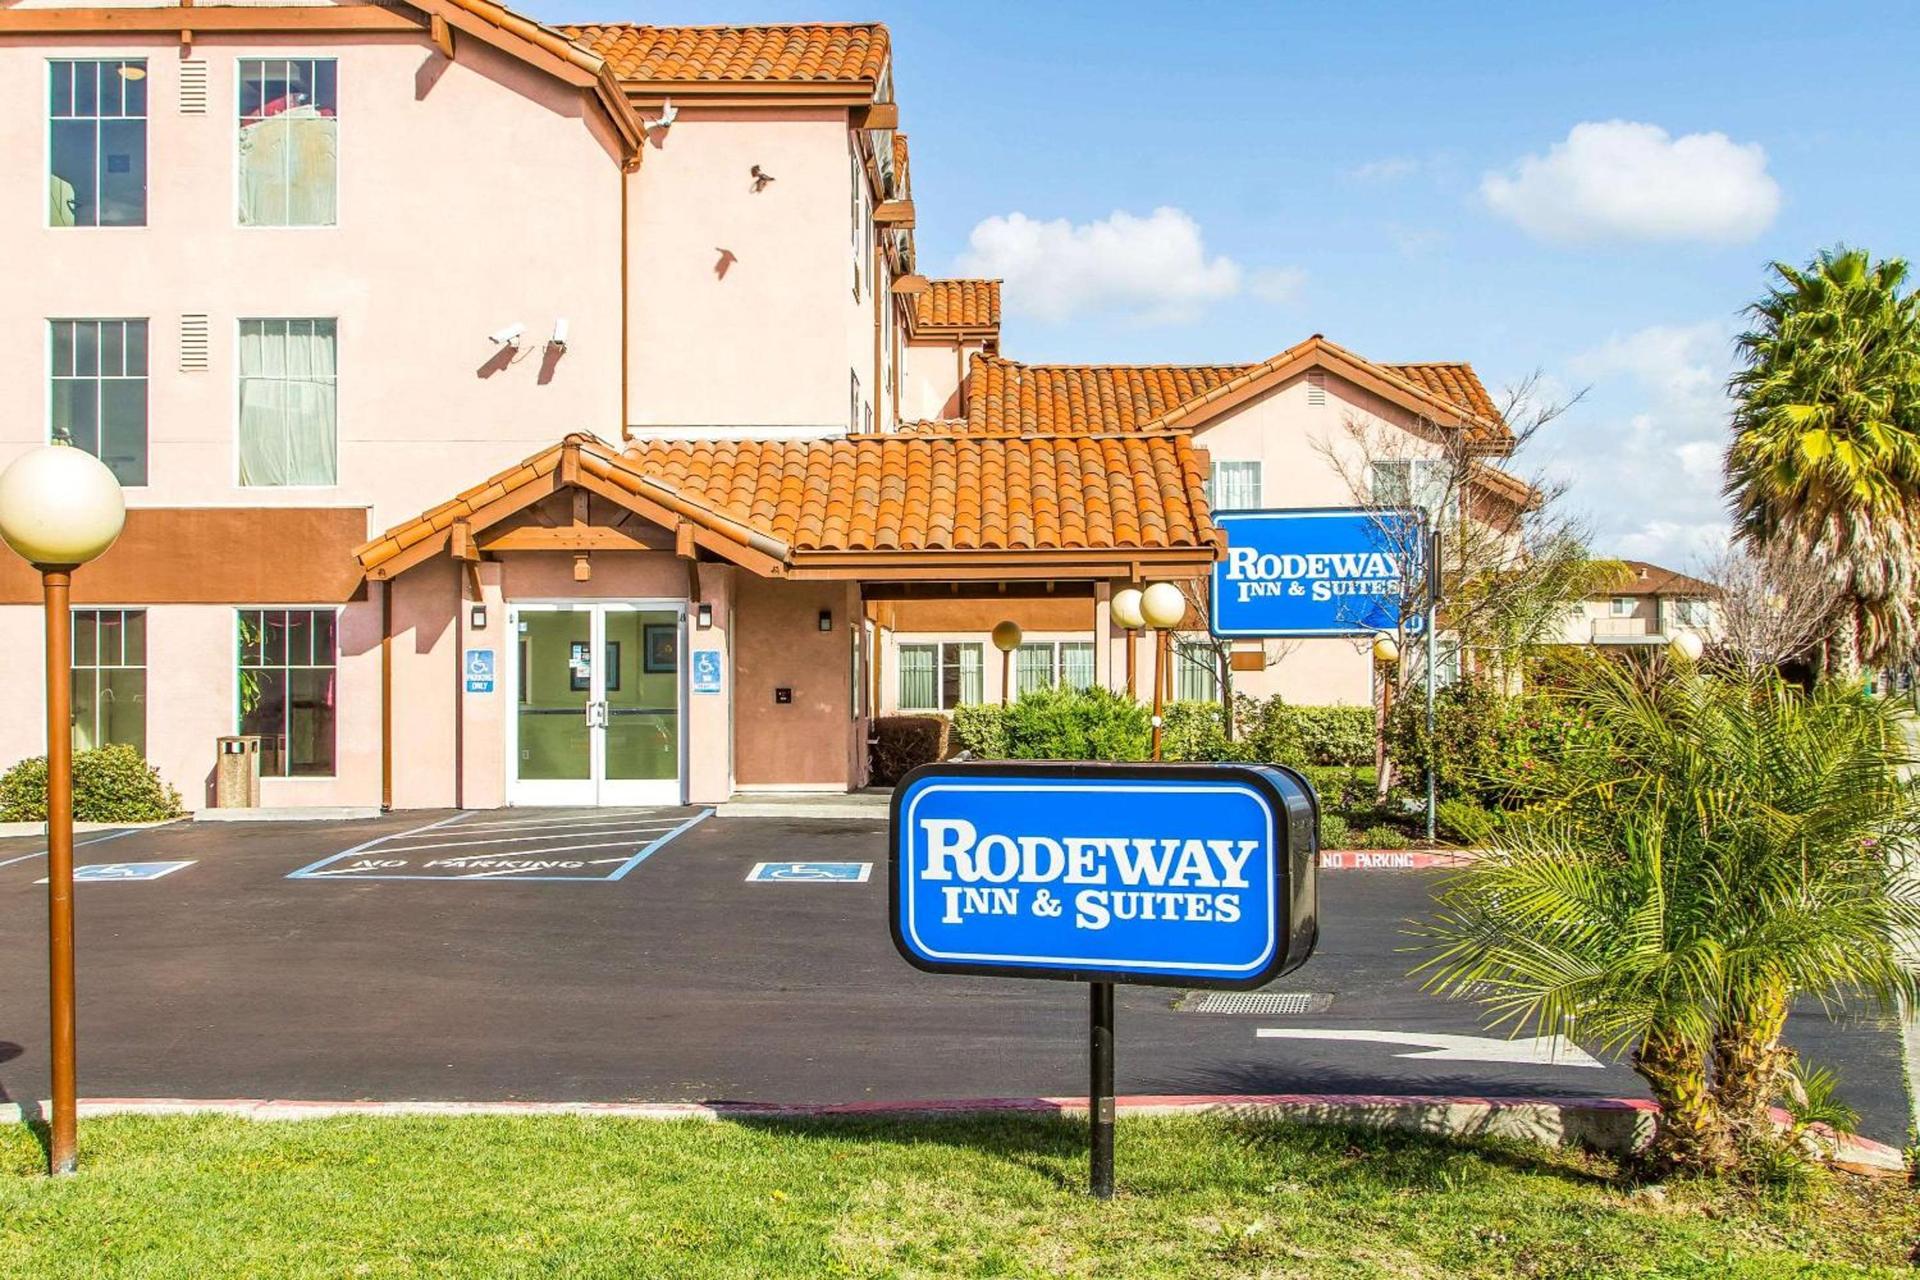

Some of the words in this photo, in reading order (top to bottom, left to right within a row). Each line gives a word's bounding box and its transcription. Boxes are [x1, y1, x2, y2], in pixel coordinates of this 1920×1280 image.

[1237, 582, 1282, 602] INN
[1288, 582, 1306, 597] &
[472, 682, 489, 690] ONLY
[920, 818, 1259, 888] RODEWAY
[1321, 853, 1342, 867] NO
[1356, 853, 1413, 867] PARKING
[350, 859, 408, 868] NO
[423, 859, 585, 869] PARKING
[941, 886, 1019, 924] INN
[1032, 889, 1062, 918] &
[1075, 889, 1241, 930] SUITES
